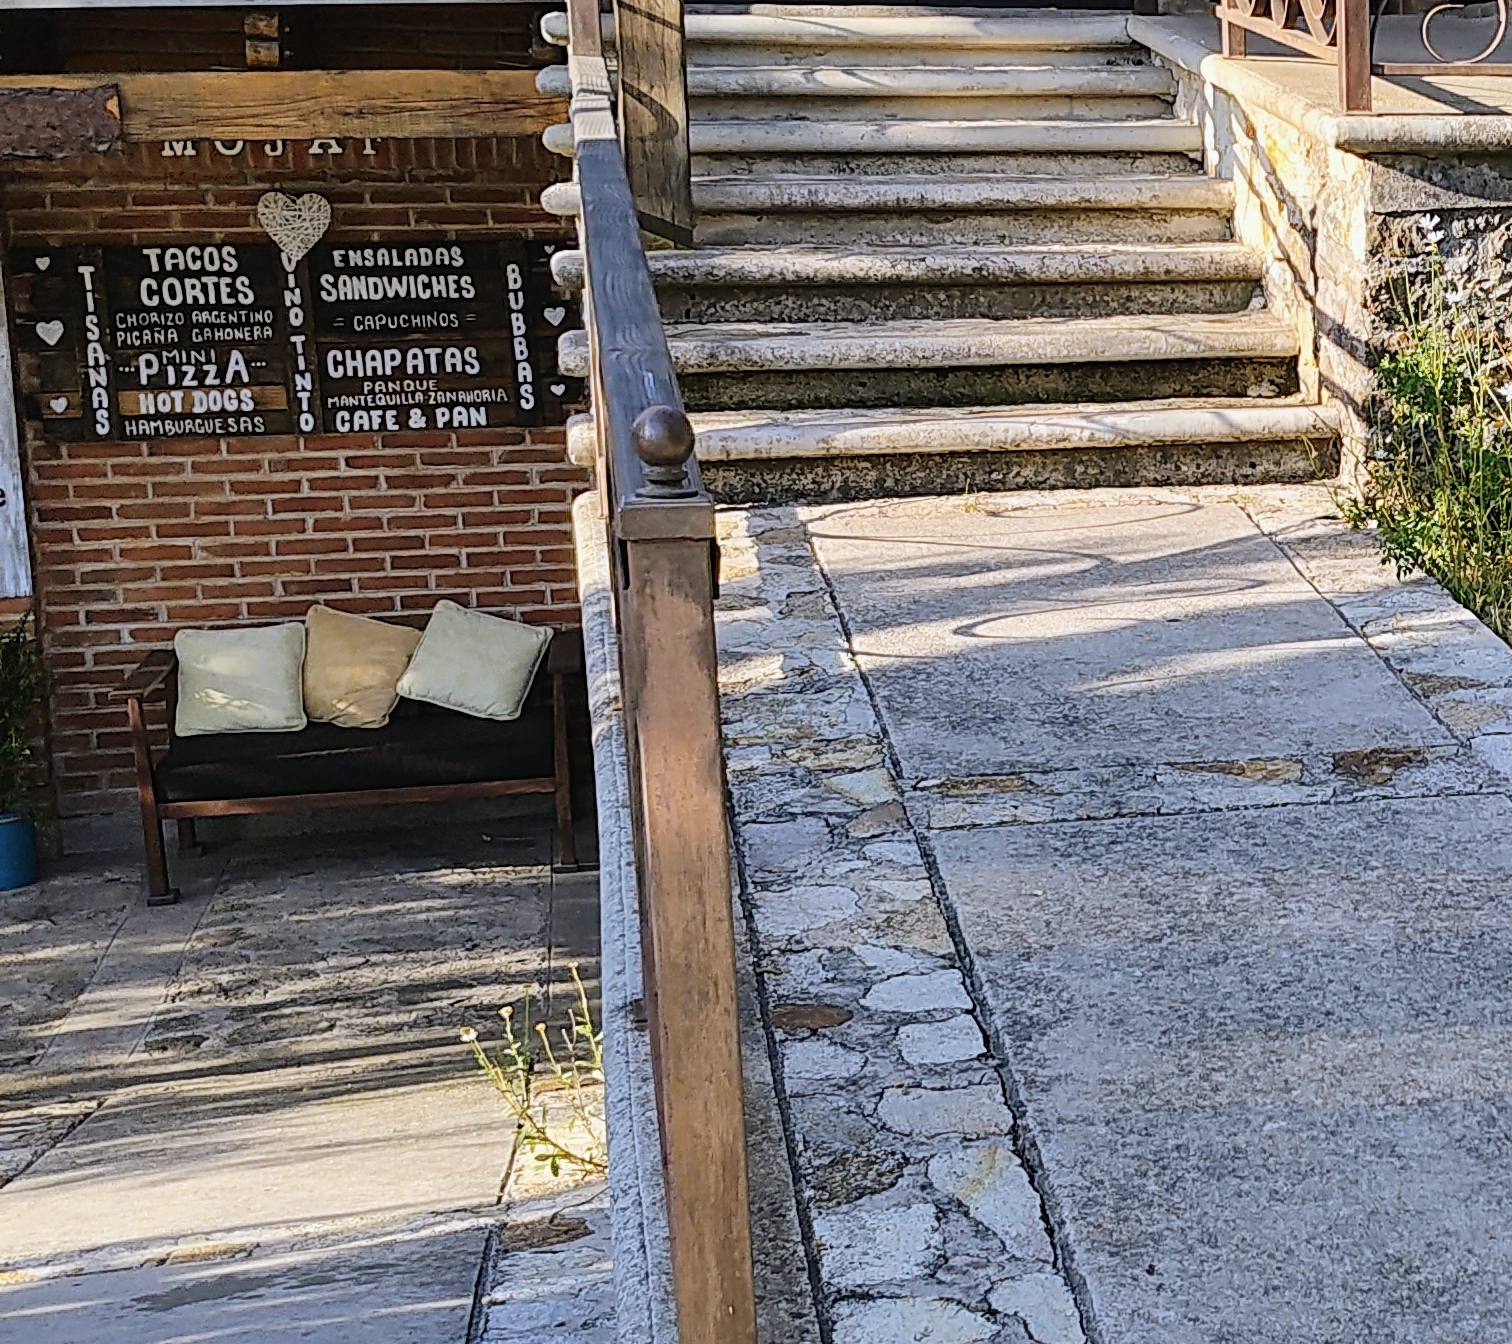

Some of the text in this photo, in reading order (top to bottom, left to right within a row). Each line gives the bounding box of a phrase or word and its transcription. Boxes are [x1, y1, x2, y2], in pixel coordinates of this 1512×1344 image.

[142, 245, 239, 273] TACOS
[332, 246, 465, 268] ENSALADAS
[140, 275, 255, 307] CORTES
[319, 273, 476, 303] SANDWICHES
[115, 309, 274, 329] CHORIZO ARGENTINO
[353, 311, 459, 332] CAPUCHINOS
[77, 265, 110, 436] TISANAS
[116, 327, 179, 347] PICAÑA
[280, 251, 315, 433] VINO TINTO
[506, 263, 536, 410] BUBBAS
[138, 349, 250, 386] PIZZA
[162, 348, 216, 365] MINI
[326, 346, 481, 379] CHAPATAS
[363, 379, 438, 395] PANQUE
[139, 388, 255, 415] HOT DOGS
[124, 416, 266, 436] HAMBURGUESAS
[335, 406, 488, 434] CAFE & PAN
